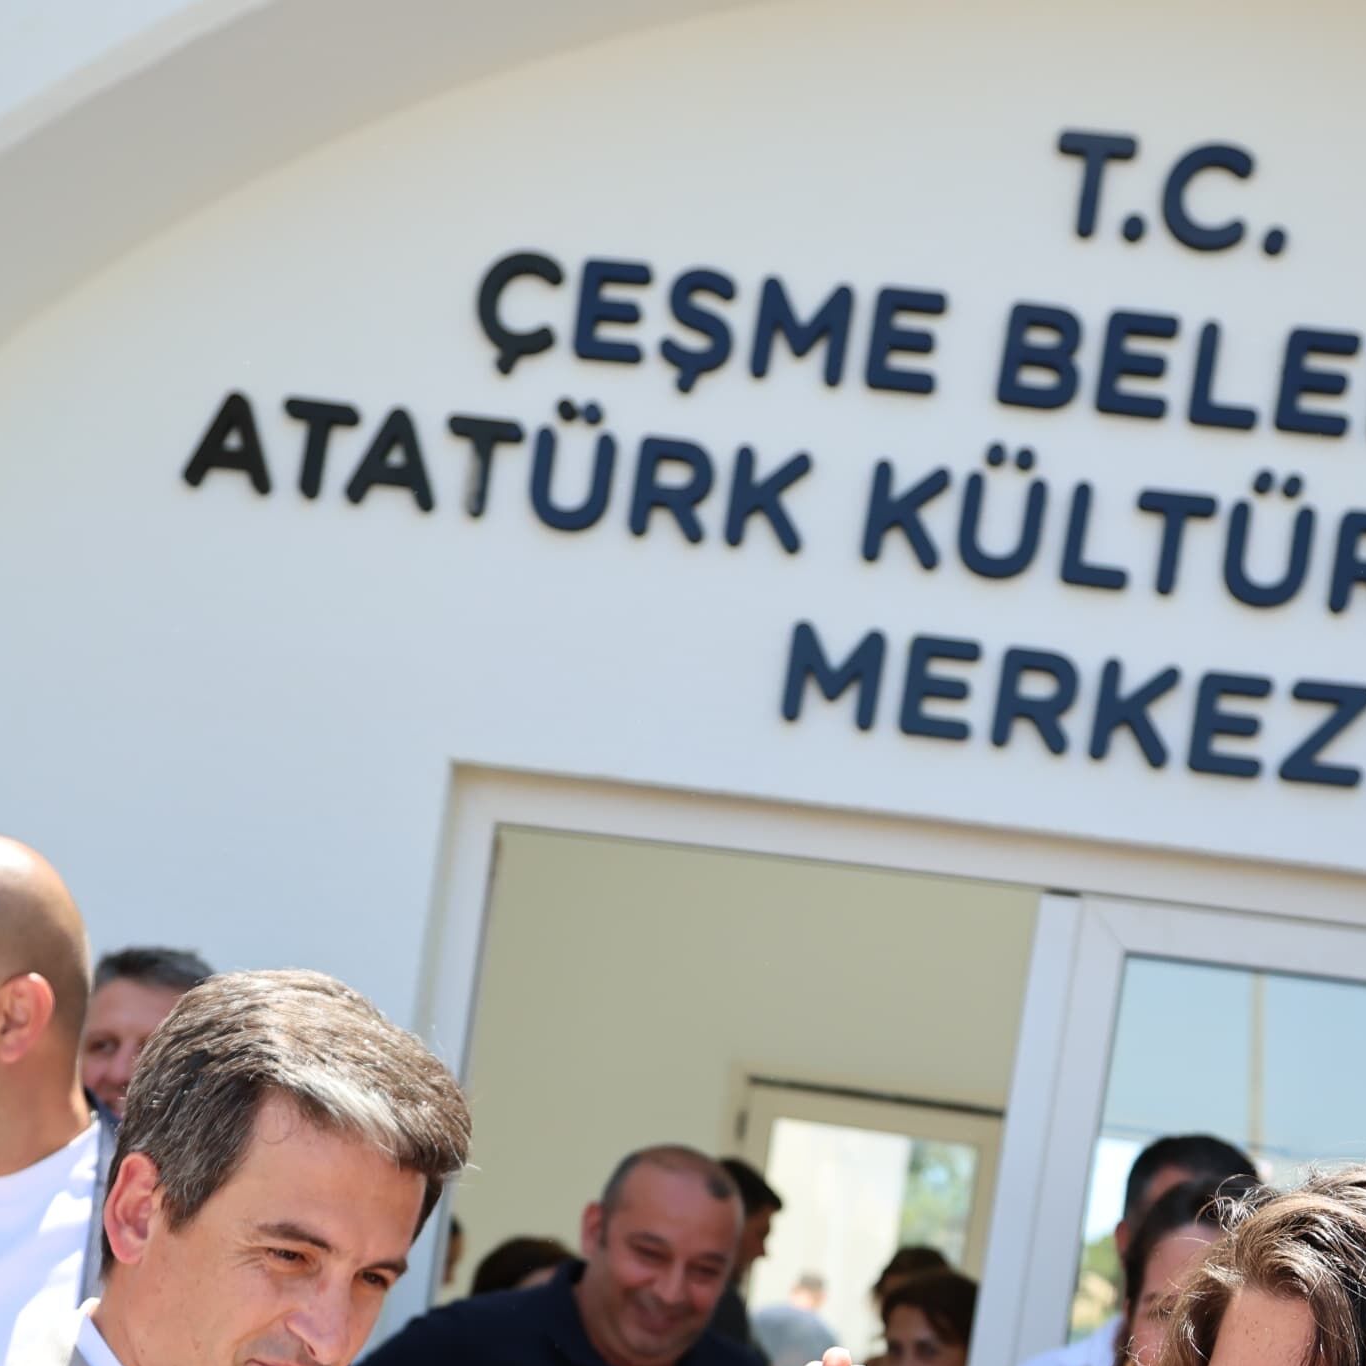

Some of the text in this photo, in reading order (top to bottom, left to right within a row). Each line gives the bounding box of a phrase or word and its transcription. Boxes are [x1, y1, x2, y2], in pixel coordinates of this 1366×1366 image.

[1055, 129, 1287, 259] T.C.
[474, 250, 950, 399] ÇEŞME
[179, 389, 814, 558] ATATÜRK
